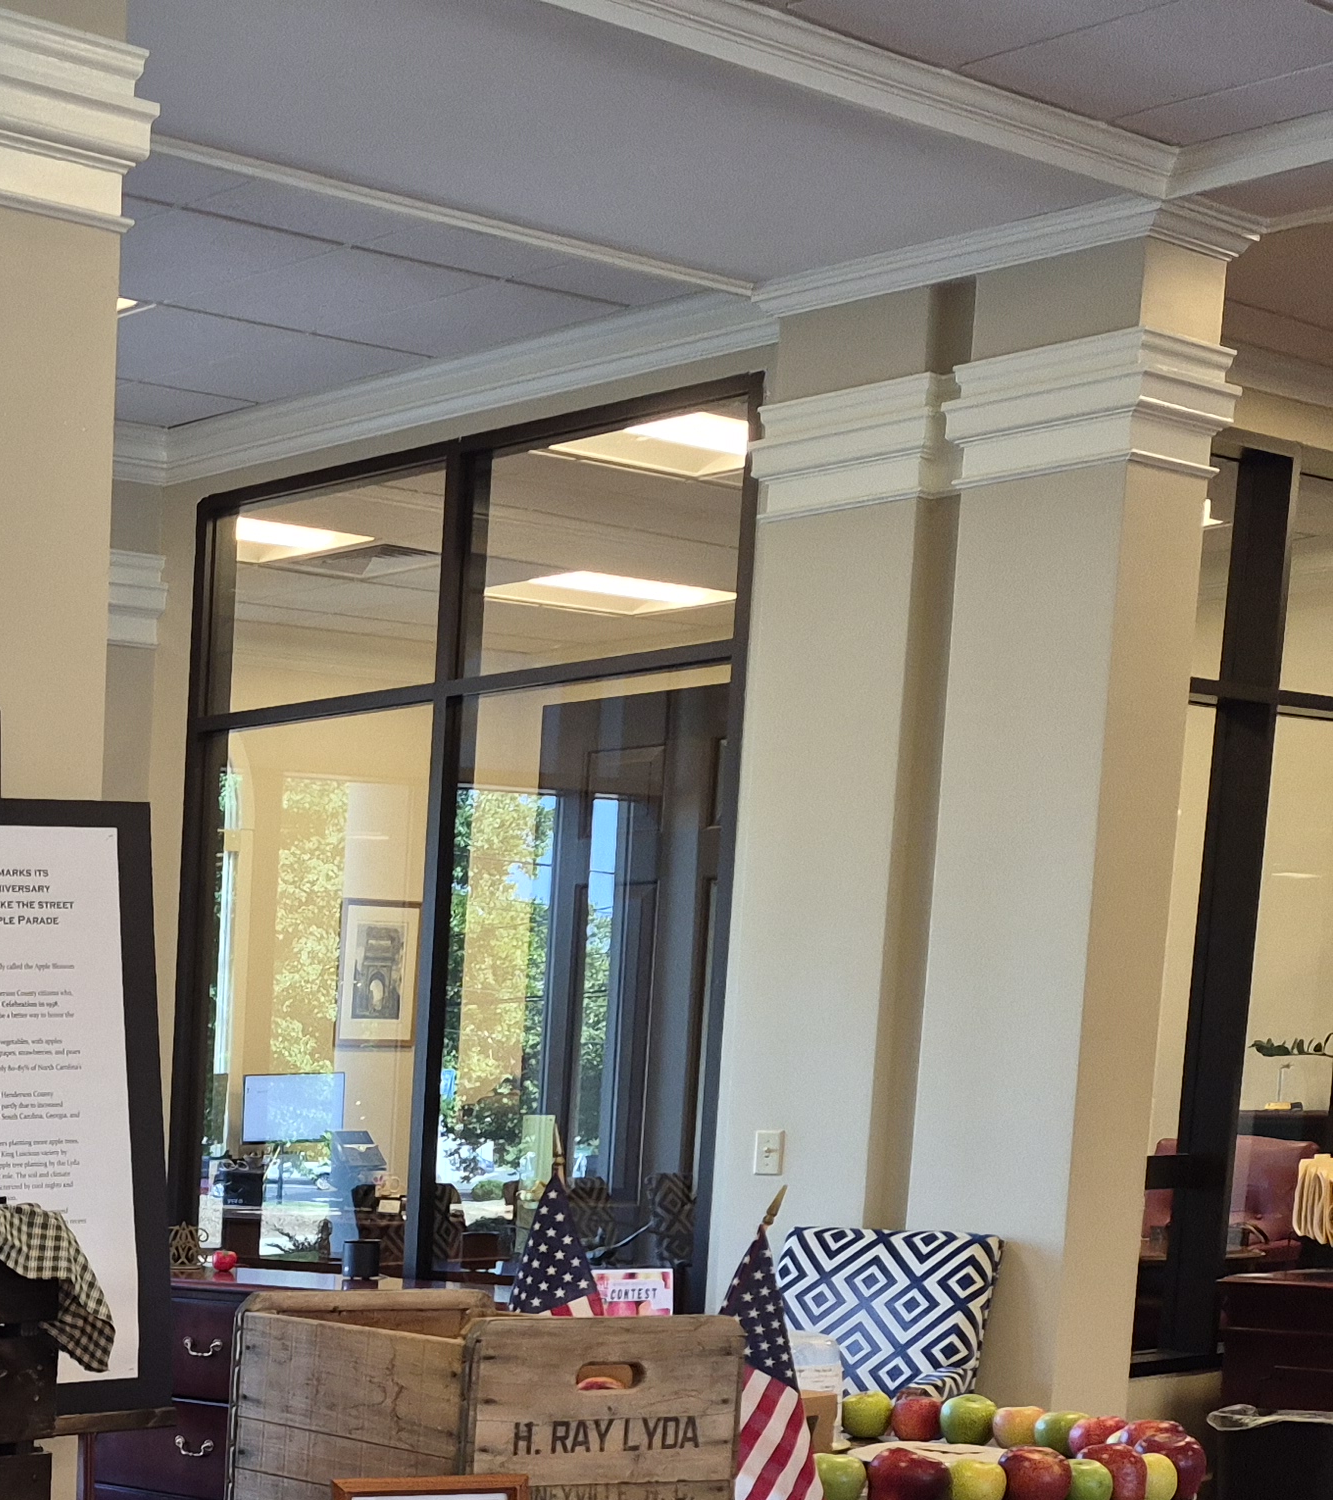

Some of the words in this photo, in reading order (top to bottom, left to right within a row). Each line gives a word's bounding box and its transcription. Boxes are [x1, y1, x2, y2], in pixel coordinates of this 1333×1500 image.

[610, 1288, 657, 1300] CONTEST
[513, 1421, 542, 1456] H.
[550, 1418, 616, 1455] RAY
[623, 1415, 700, 1452] LYDA
